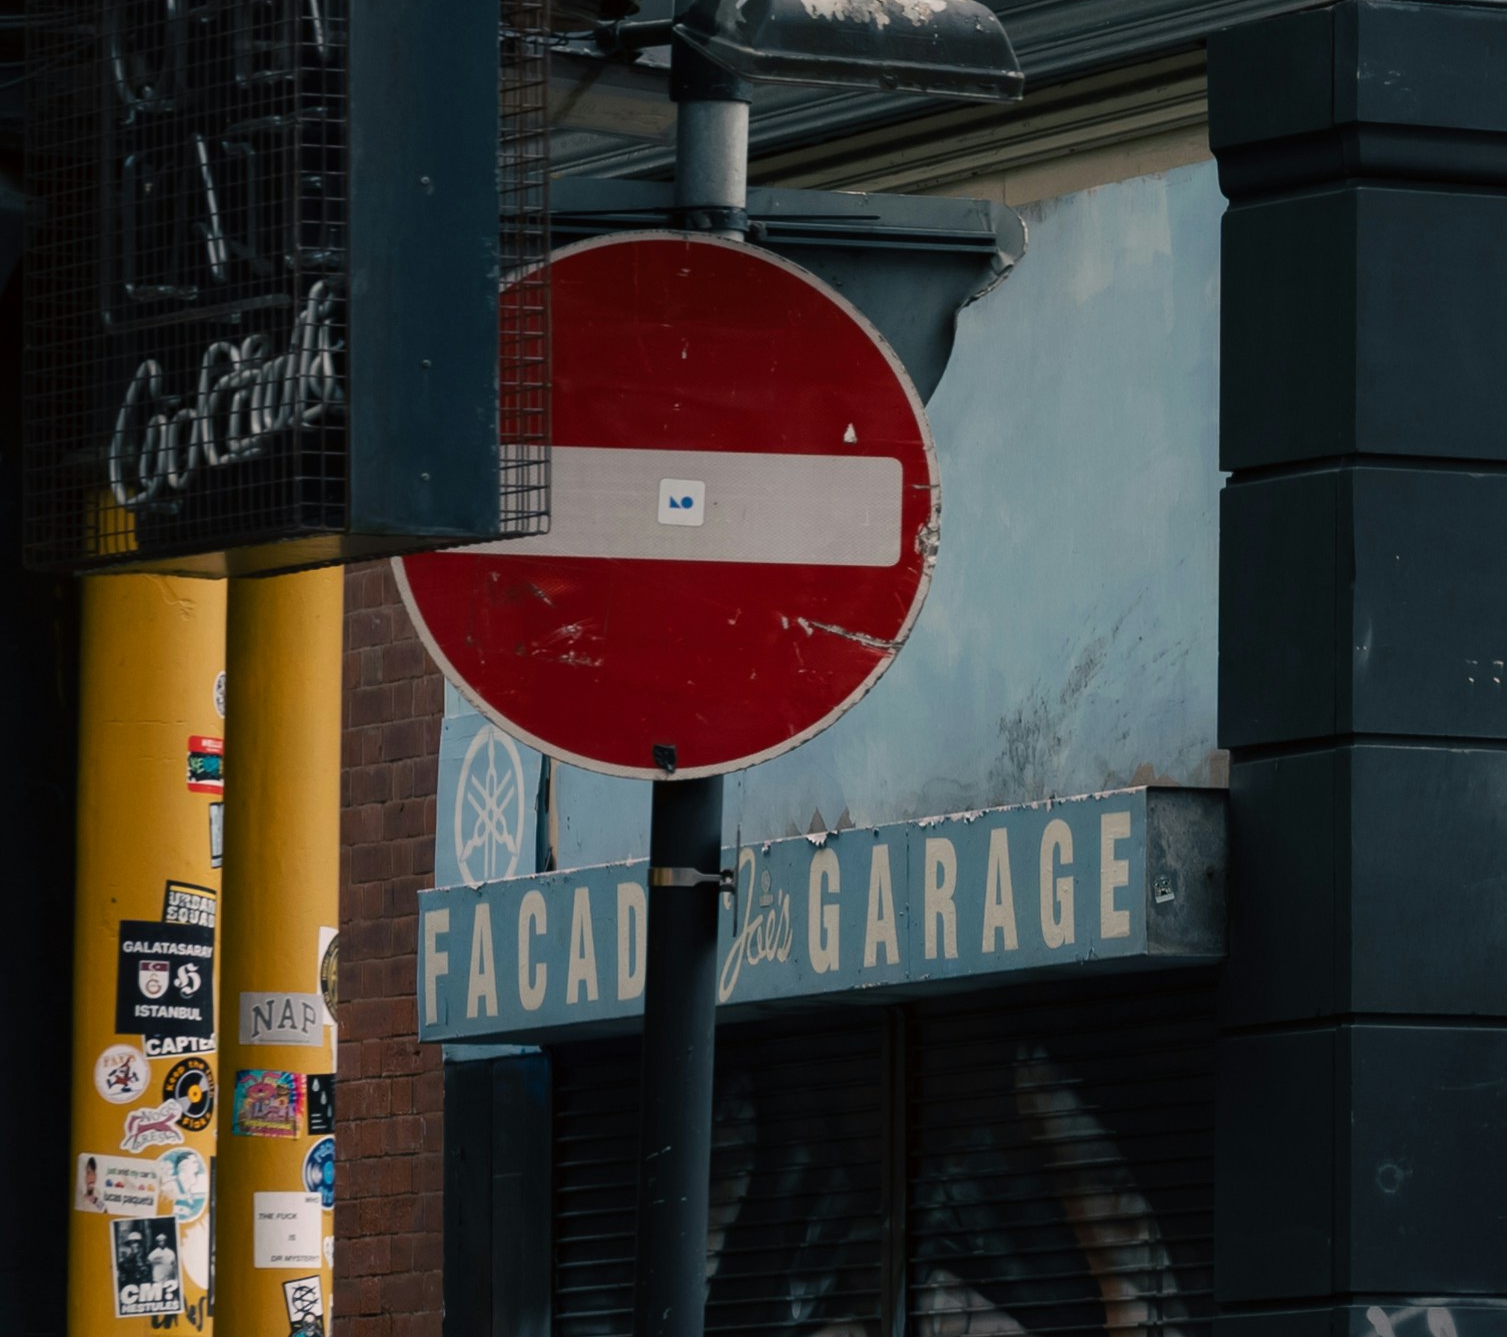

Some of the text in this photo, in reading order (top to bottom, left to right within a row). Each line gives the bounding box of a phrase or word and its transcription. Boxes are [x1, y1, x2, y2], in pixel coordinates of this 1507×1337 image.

[808, 811, 1134, 975] GARAGE
[122, 940, 214, 959] GALATASARAY
[134, 1004, 202, 1021] ISTANBUL
[251, 998, 317, 1039] NAP
[275, 1212, 298, 1221] FUCK
[119, 1279, 180, 1304] CM?
